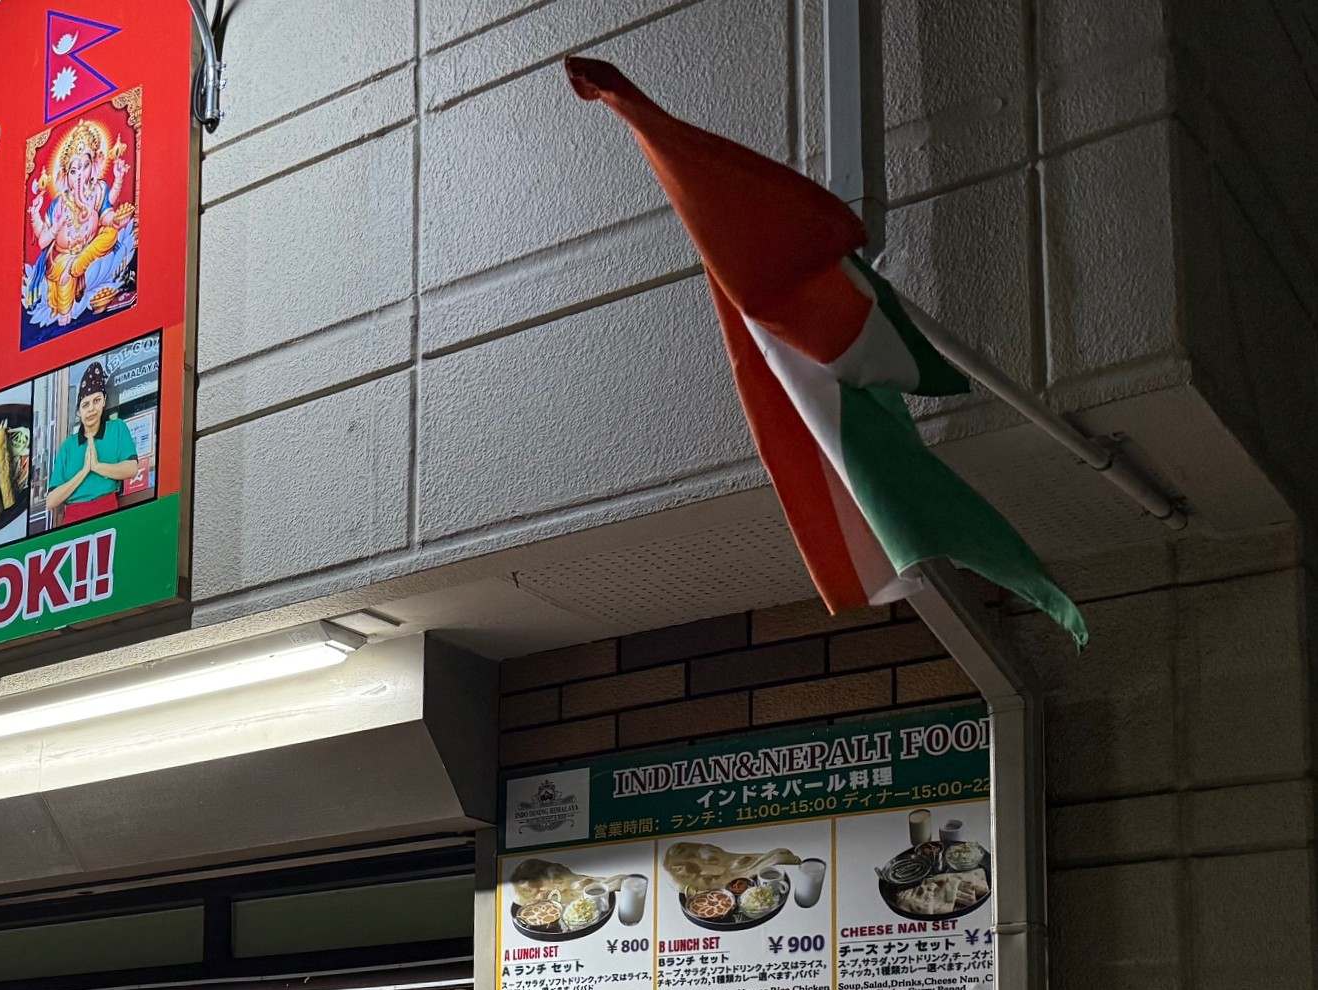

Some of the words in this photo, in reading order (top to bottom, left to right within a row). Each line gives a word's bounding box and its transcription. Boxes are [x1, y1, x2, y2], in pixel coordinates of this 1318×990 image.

[613, 731, 892, 798] INDIAN&NEPALI
[696, 766, 893, 809] インドネパール料理
[841, 924, 893, 938] CHEESE
[898, 922, 927, 934] NAN
[932, 920, 958, 931] SET
[513, 947, 540, 960] LUNCH
[543, 946, 558, 957] SET
[669, 939, 699, 951] LUNCH
[703, 937, 720, 949] SET
[769, 935, 825, 953] ¥900
[840, 945, 878, 957] チーズ
[884, 942, 909, 953] ナン
[916, 939, 955, 951] セット
[515, 965, 546, 975] ランチ
[552, 961, 584, 972] セット
[659, 956, 695, 967] Bランチ
[700, 954, 729, 964] セット
